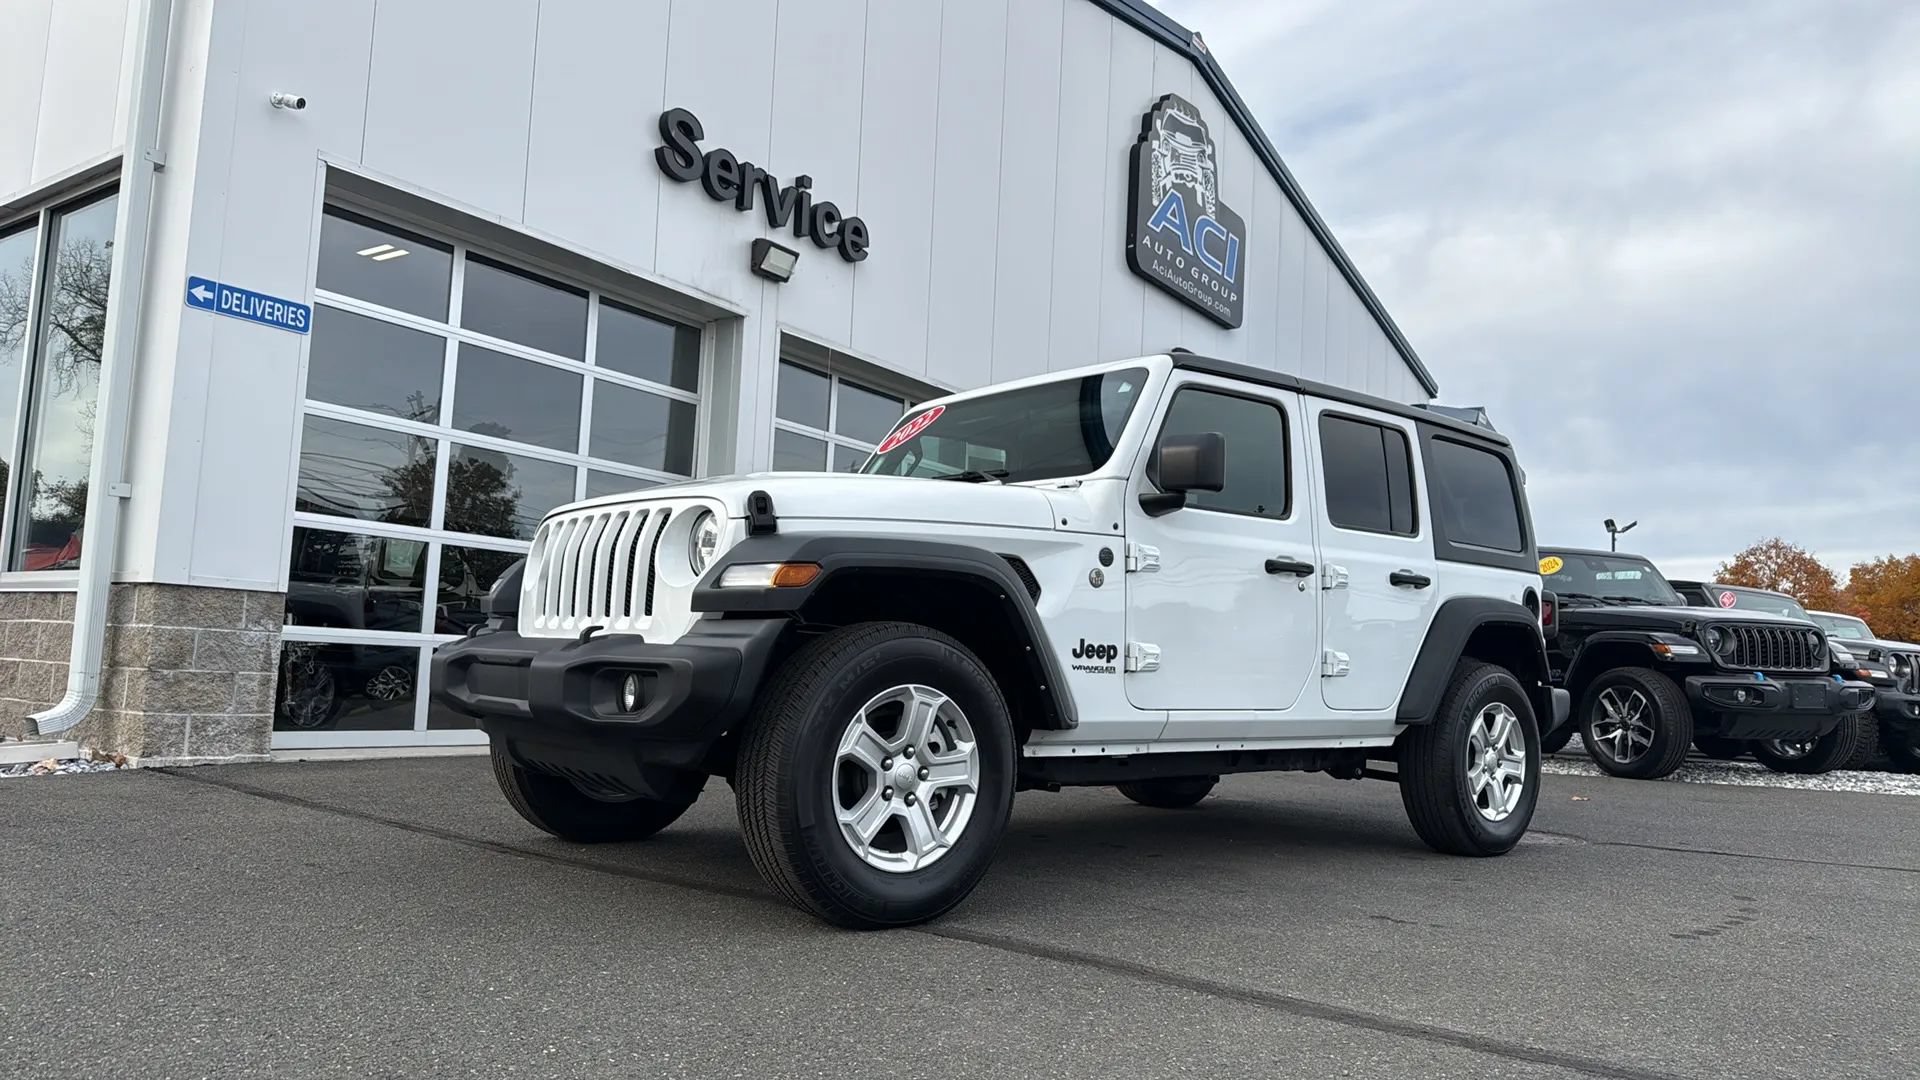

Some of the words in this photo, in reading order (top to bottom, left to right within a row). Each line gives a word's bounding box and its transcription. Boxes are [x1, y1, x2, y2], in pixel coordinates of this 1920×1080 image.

[655, 108, 869, 263] Service
[1147, 188, 1239, 284] ACI
[1142, 235, 1186, 269] AUTO
[1190, 264, 1238, 302] GROUP
[1152, 259, 1231, 318] AciAutoGroup.com
[221, 289, 306, 328] DELIVERIES
[1072, 638, 1118, 663] Jeep
[1072, 664, 1116, 672] WRANGLER
